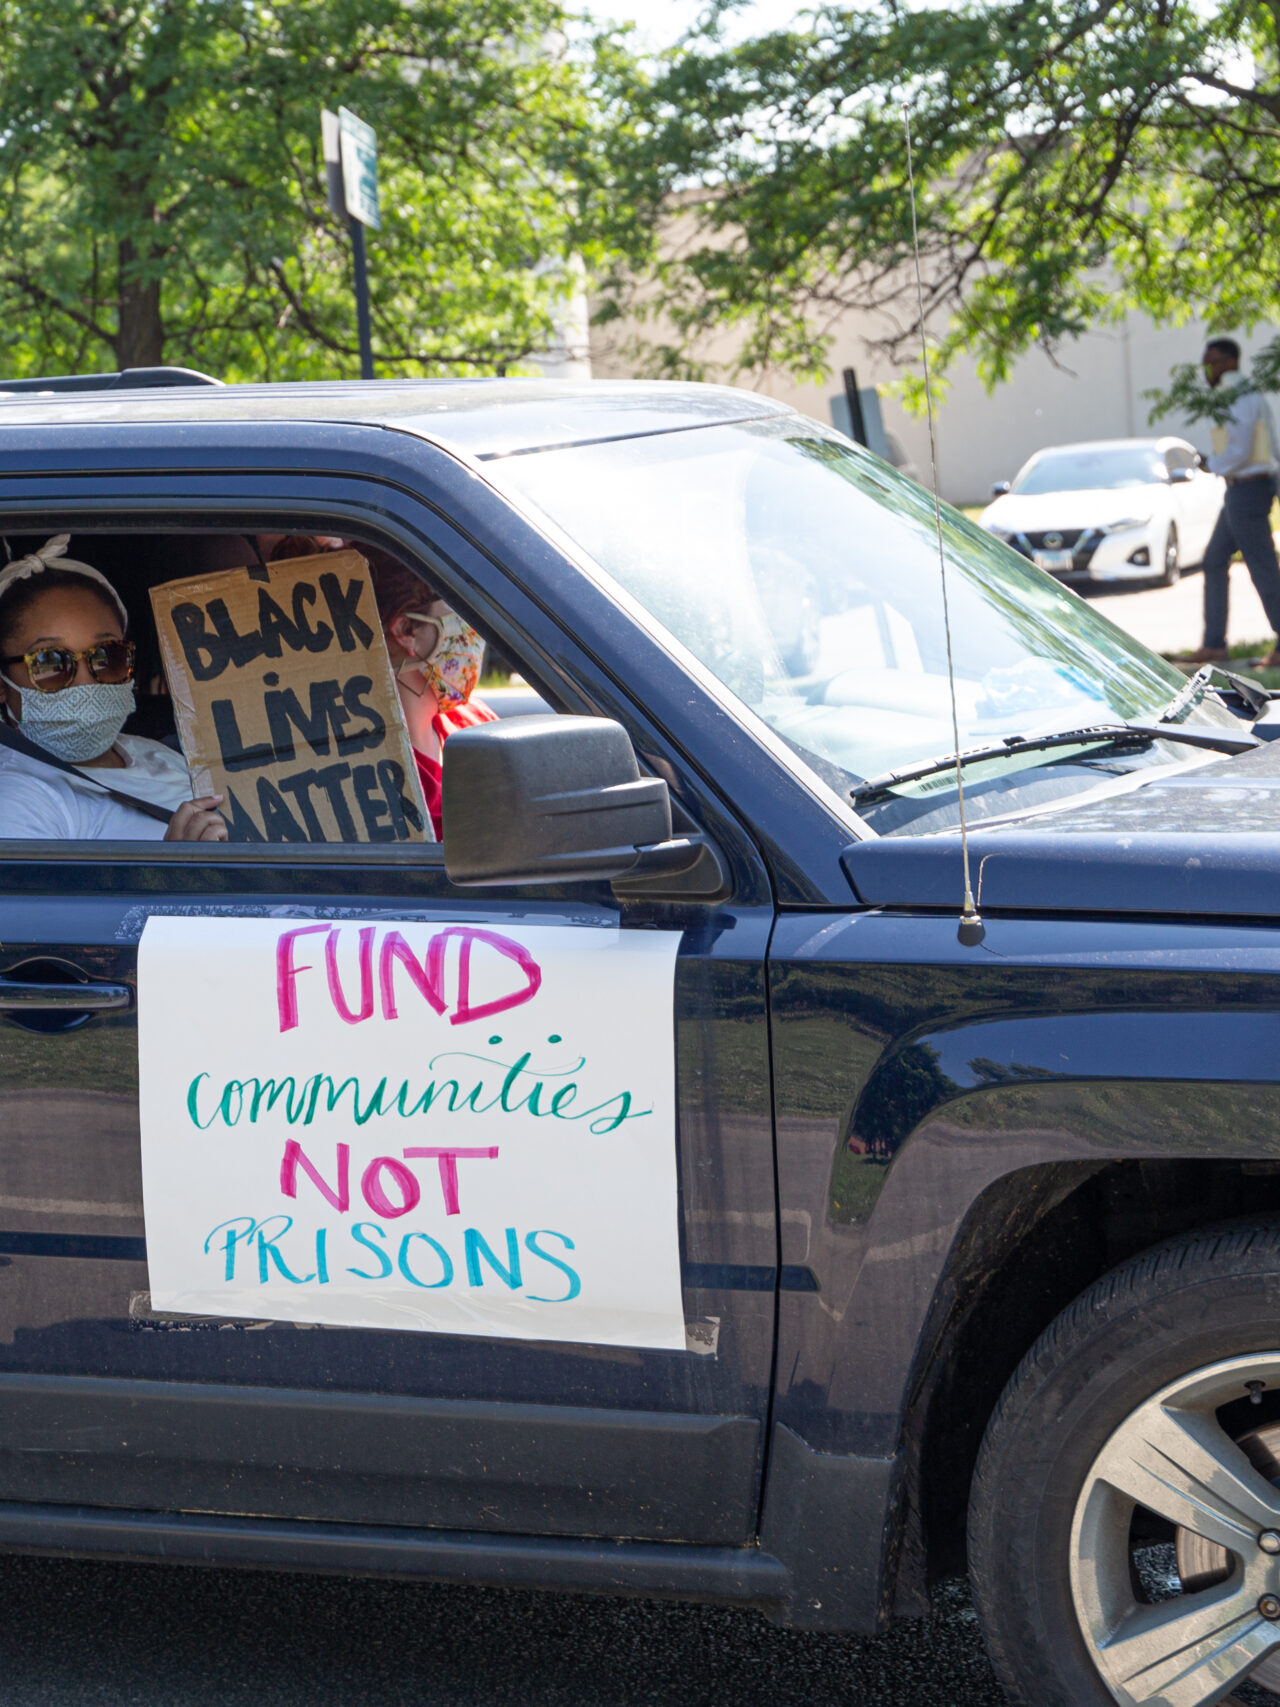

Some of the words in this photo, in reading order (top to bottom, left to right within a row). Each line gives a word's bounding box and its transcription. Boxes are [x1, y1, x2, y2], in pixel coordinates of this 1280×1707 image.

[171, 572, 374, 681] BLACK
[276, 923, 542, 1032] FUND
[280, 1139, 499, 1220] NOT
[204, 1214, 581, 1303] PRISONS
